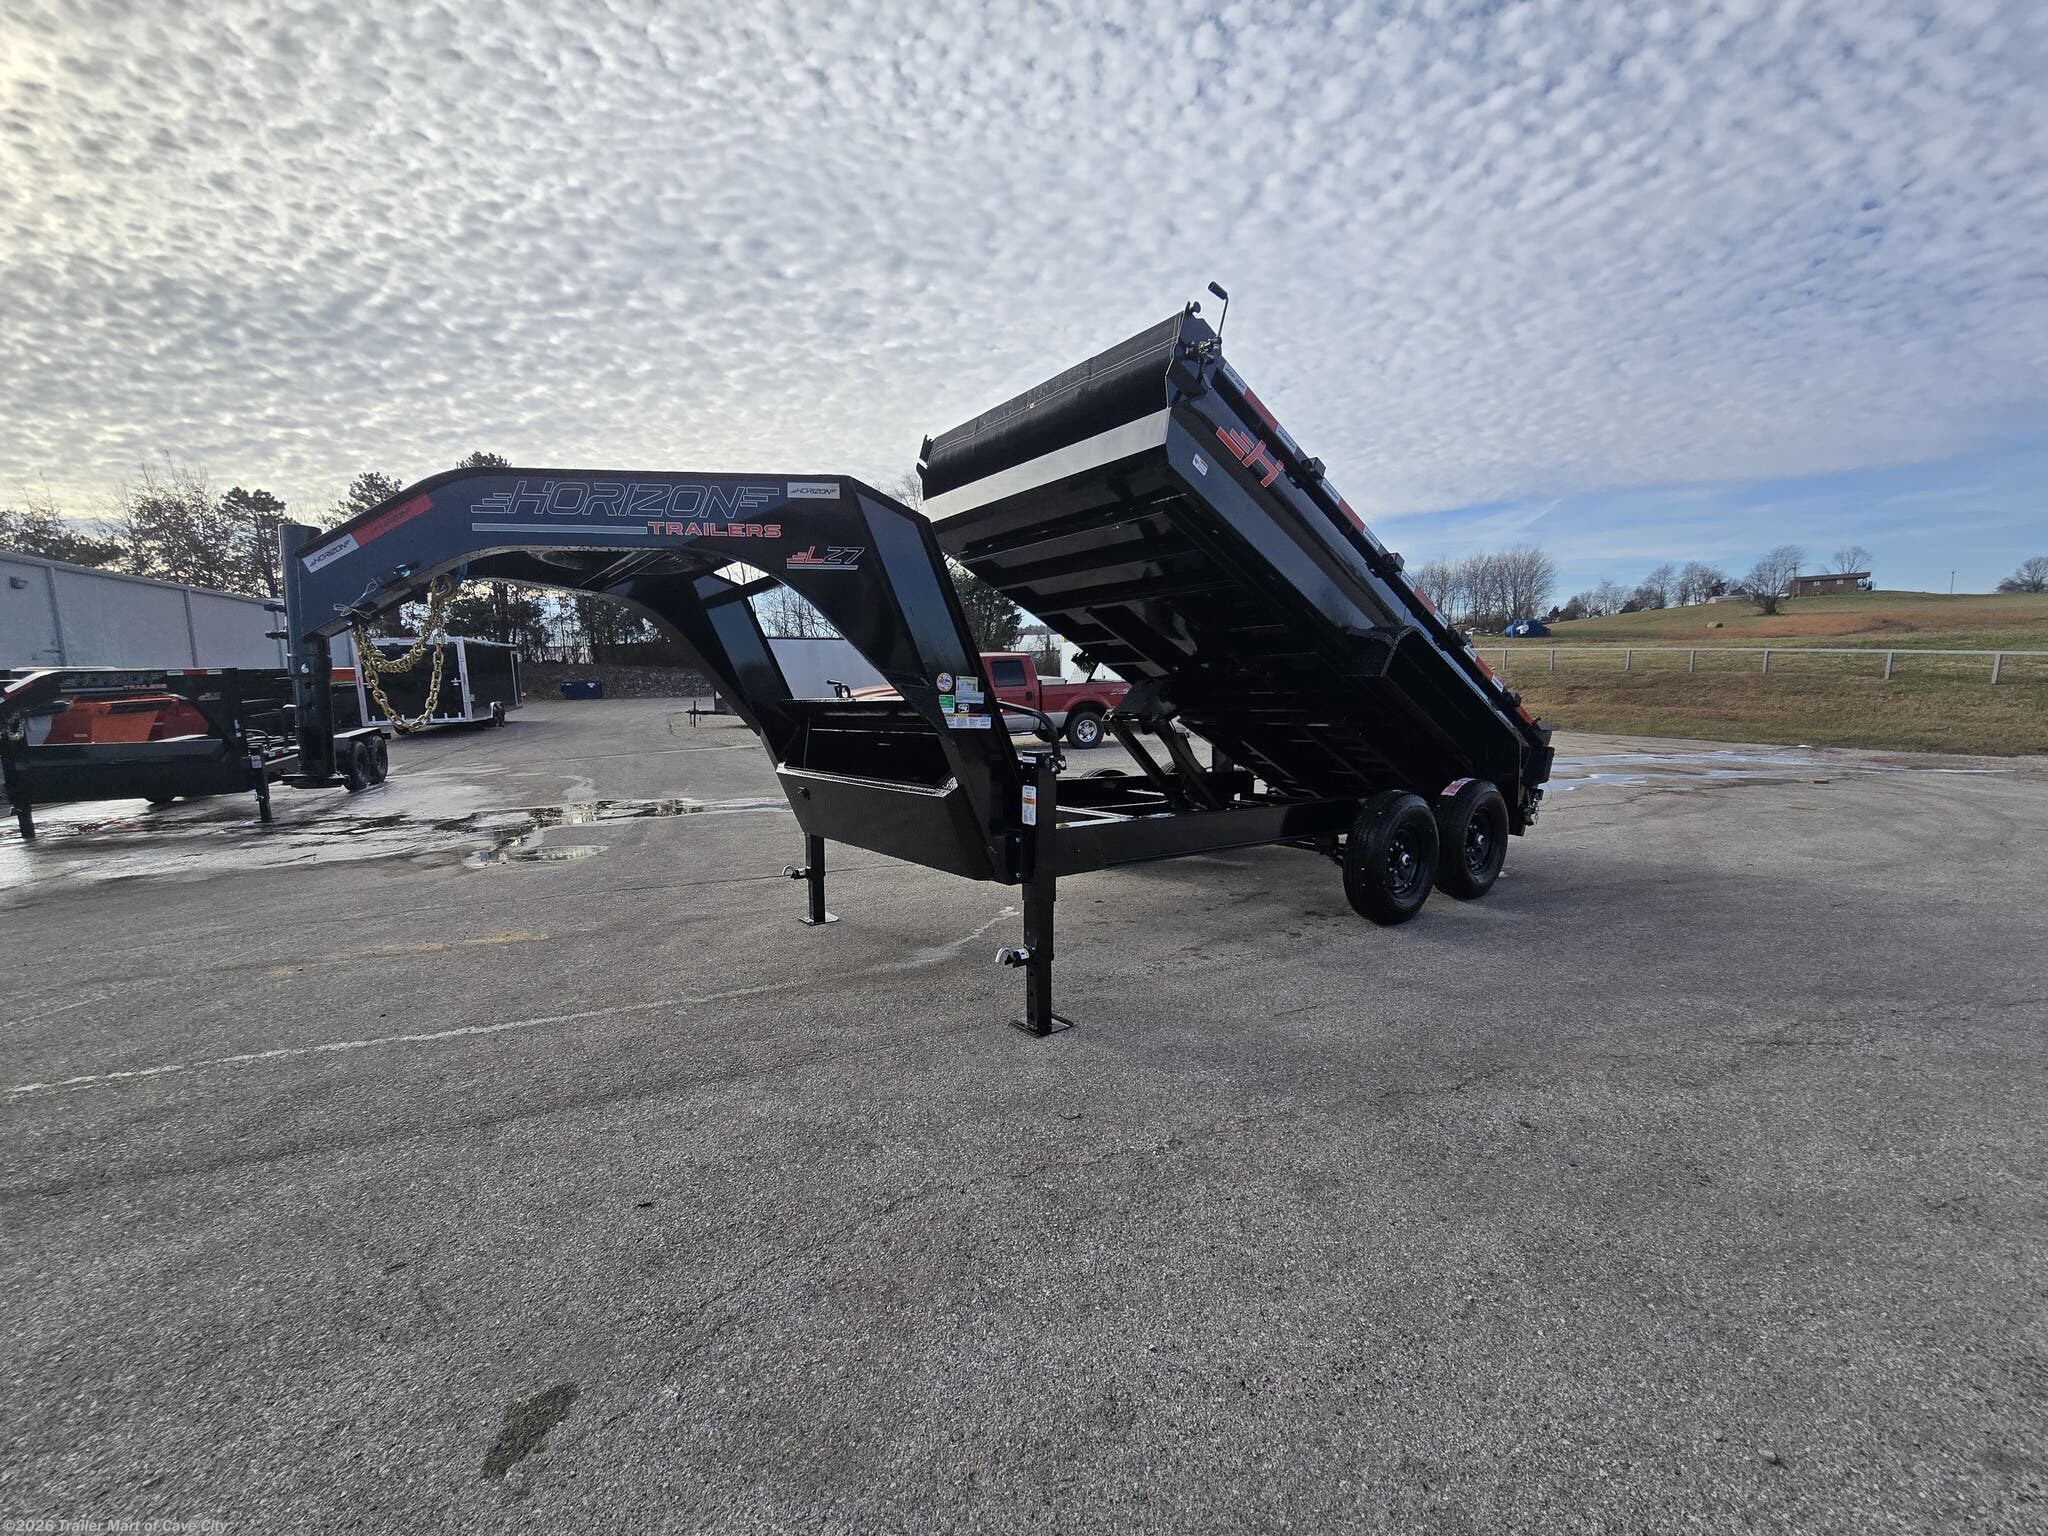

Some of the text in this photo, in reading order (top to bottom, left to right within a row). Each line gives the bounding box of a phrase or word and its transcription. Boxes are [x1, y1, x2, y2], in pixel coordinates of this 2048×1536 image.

[506, 480, 746, 519] HORIZON
[793, 487, 836, 495] HORIZON
[648, 522, 782, 538] TRAILERS
[311, 540, 350, 564] HORIZON
[804, 545, 866, 565] L27
